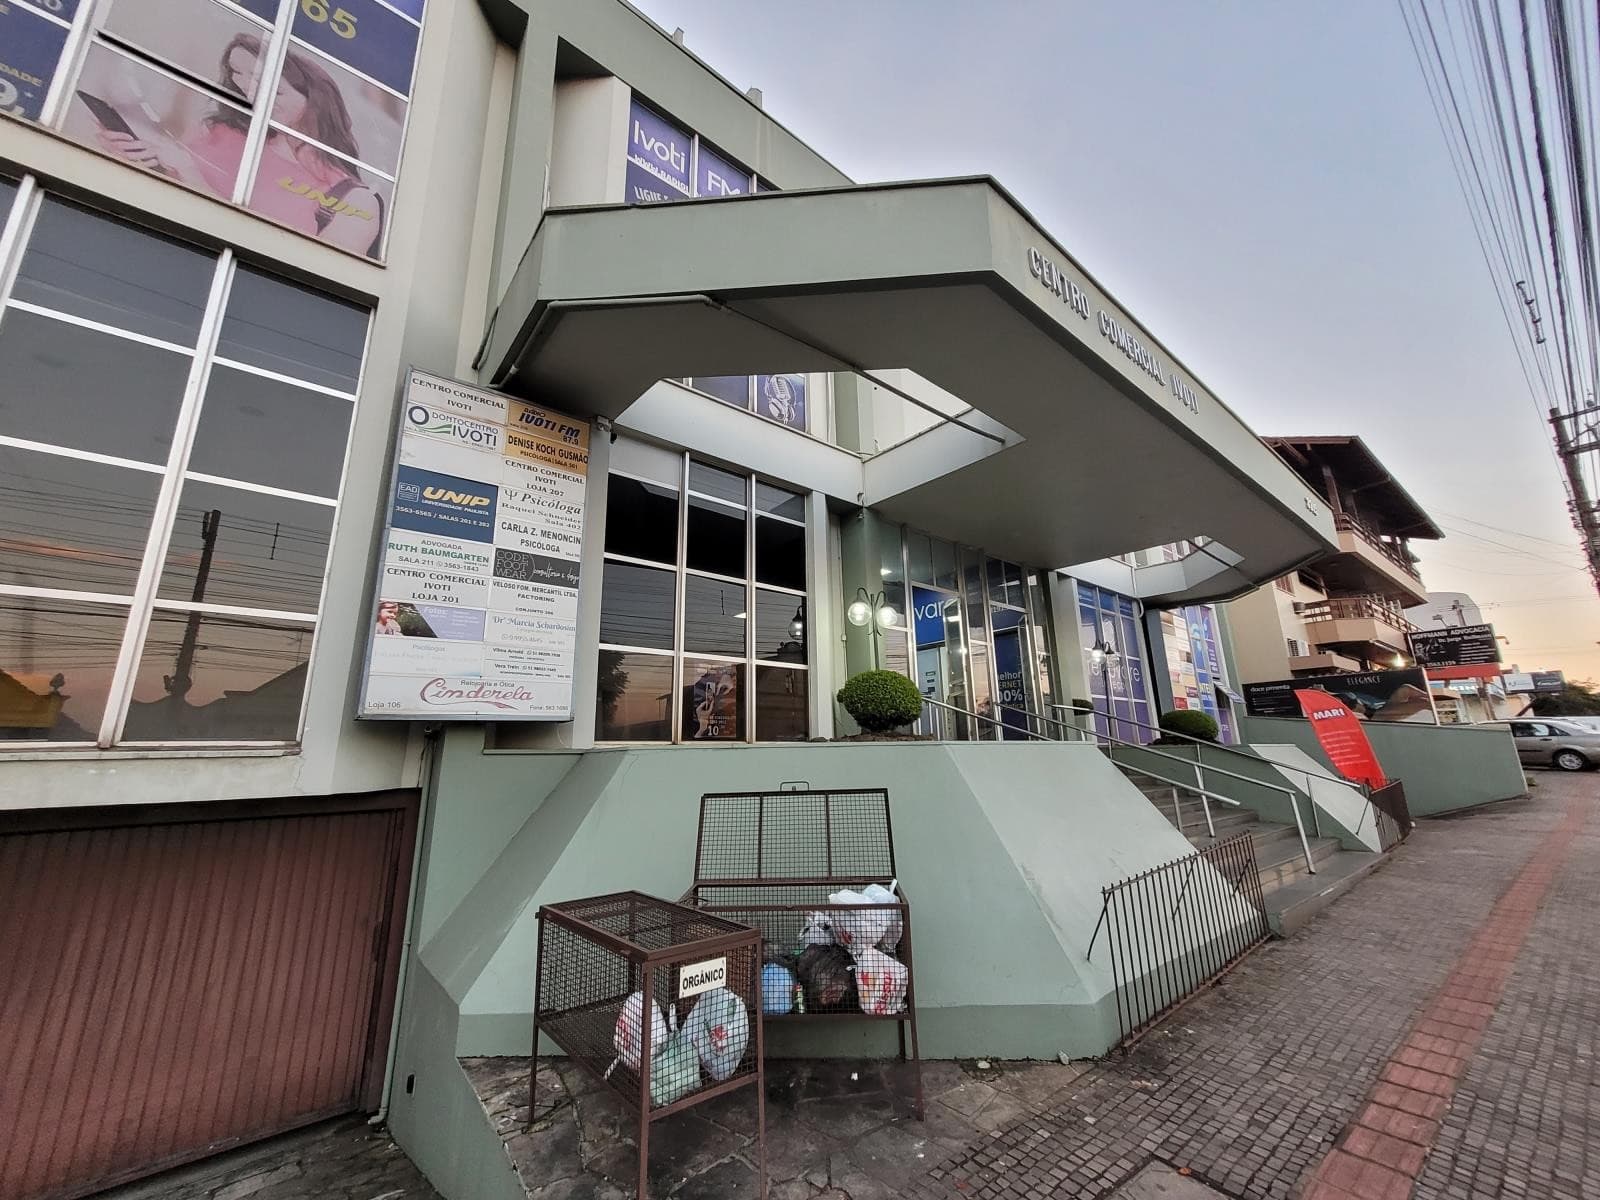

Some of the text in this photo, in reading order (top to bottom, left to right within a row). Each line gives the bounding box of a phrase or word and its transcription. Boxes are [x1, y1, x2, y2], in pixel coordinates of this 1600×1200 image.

[633, 119, 686, 174] Ivoti
[1027, 247, 1199, 415] CENTRO COMERCIAL IVOTI
[412, 378, 506, 410] CENTRO COMERCIAL
[447, 399, 472, 411] IVOTI
[519, 413, 557, 431] IVOTI
[558, 424, 581, 438] FM
[452, 425, 497, 447] IVOTI
[562, 435, 580, 446] 87.9
[508, 435, 535, 451] DENISE
[535, 442, 556, 457] KOCH
[558, 448, 589, 465] GUSMÃO
[505, 459, 585, 485] CENTRO COMERCIAL
[535, 475, 557, 486] IVOTI
[400, 484, 418, 494] EAD
[422, 486, 490, 506] UNIP
[526, 483, 565, 497] LOJA 207
[521, 493, 581, 515] Psicóloga
[501, 521, 581, 545] CARLA Z. MENONCIN
[421, 540, 462, 550] ADVOGADA
[388, 542, 490, 563] RUTH BAUMGARTEN
[496, 550, 529, 563] CODE
[398, 556, 420, 564] SALA
[496, 558, 529, 572] FOOT
[386, 567, 487, 587] CENTRO COMERCIAL
[495, 567, 527, 580] WEAR
[423, 582, 451, 591] IVOTI
[493, 580, 516, 590] VELOSO
[531, 586, 563, 597] MERCANTIL
[411, 592, 459, 603] LOJA 201
[517, 593, 556, 603] FACTORING
[1346, 675, 1382, 686] ELEGANCE
[420, 677, 534, 706] Cinderela
[368, 701, 385, 710] Loja
[1312, 708, 1345, 721] MARI
[682, 967, 724, 990] ORGÂNICO
